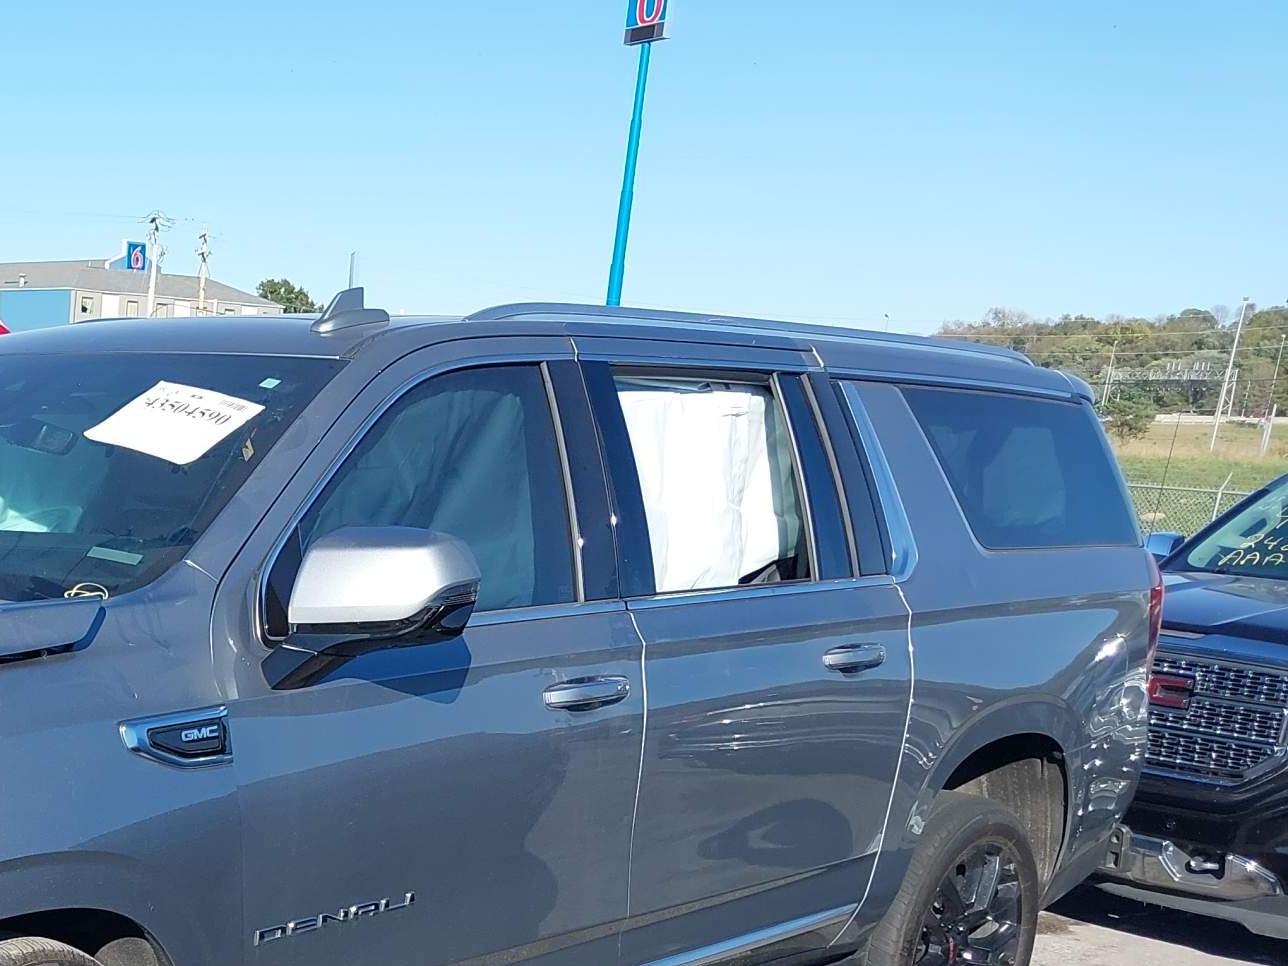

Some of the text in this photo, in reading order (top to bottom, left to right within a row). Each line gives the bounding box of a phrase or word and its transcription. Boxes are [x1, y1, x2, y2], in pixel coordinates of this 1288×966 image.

[131, 246, 144, 269] 6
[144, 396, 232, 426] 43504590
[181, 725, 219, 742] GMC
[253, 891, 416, 947] DENALI
